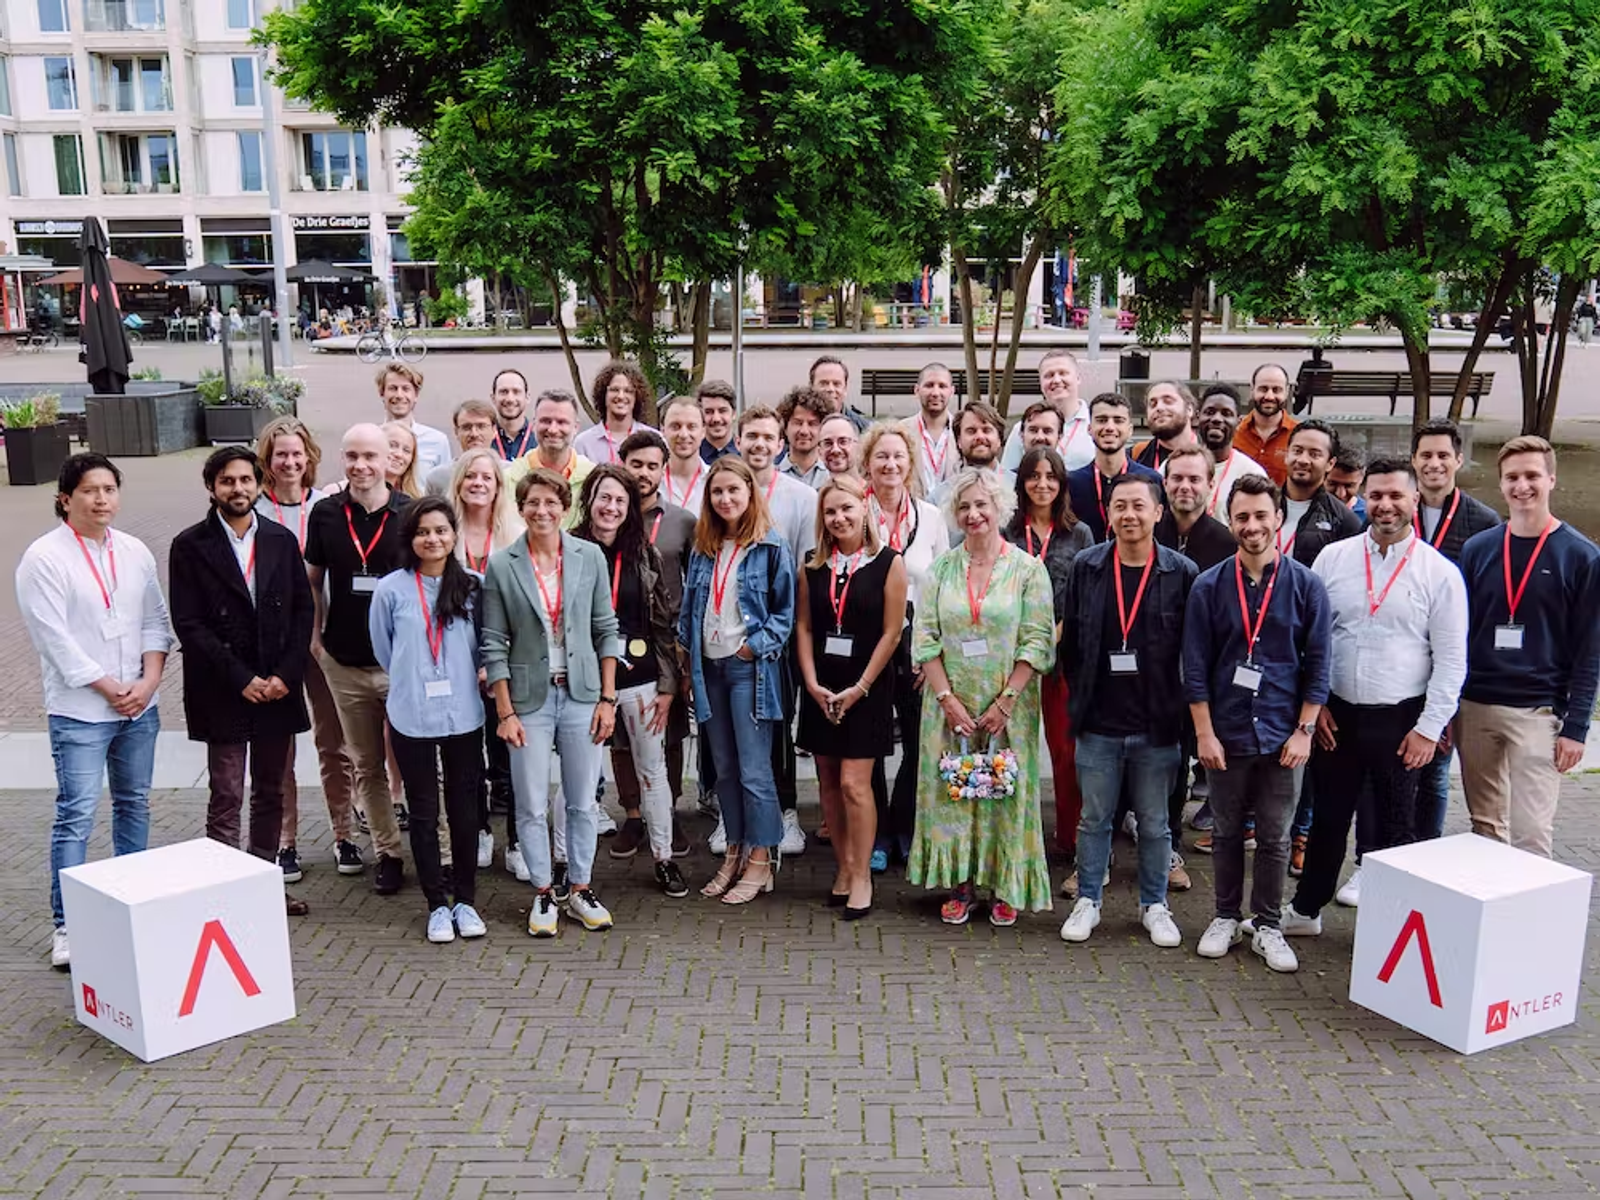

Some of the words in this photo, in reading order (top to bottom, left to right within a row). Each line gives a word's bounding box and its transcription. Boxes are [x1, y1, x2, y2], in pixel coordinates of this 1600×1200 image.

[293, 217, 305, 227] De
[307, 217, 328, 227] Drie
[84, 986, 134, 1031] ANTLER
[1488, 992, 1563, 1031] ANTLER
